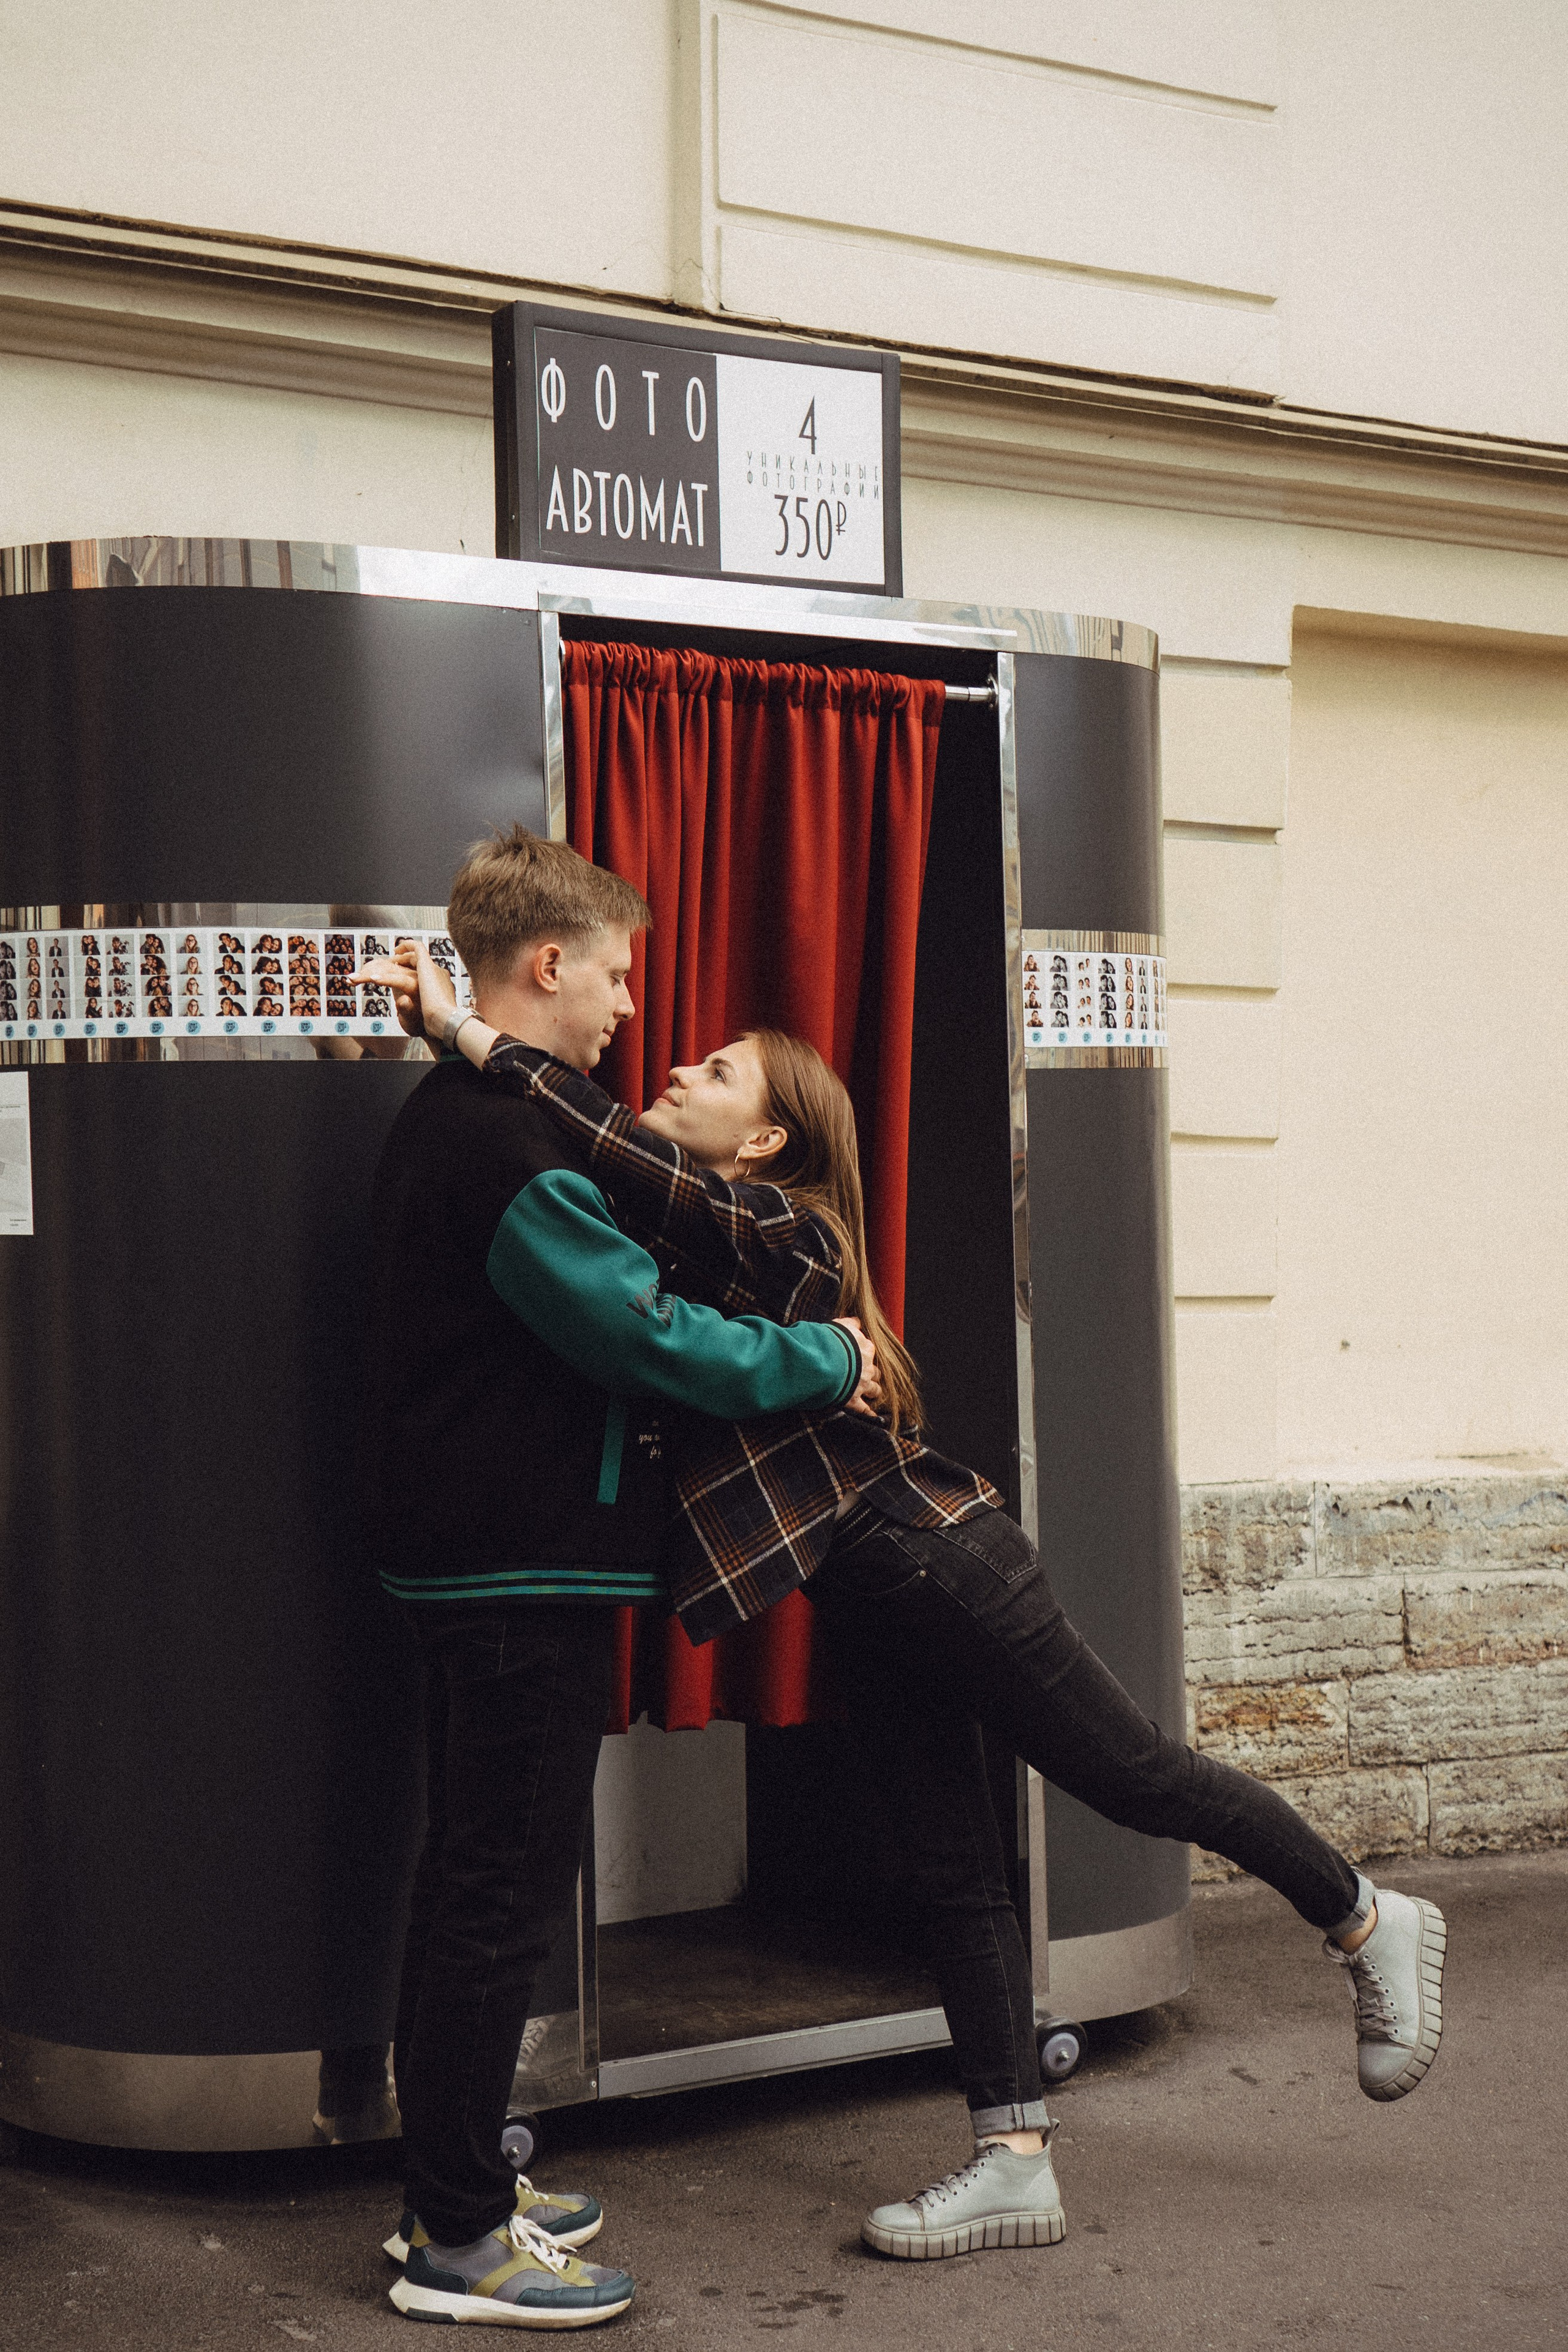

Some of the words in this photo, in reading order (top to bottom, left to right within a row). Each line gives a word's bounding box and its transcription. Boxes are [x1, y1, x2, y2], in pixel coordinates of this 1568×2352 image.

[541, 358, 707, 442] ФОТО
[799, 395, 816, 454] 4
[747, 451, 878, 481] УНИКАЛЬНЫЕ
[747, 470, 879, 500] ФОТОГРАФИИ
[546, 464, 708, 547] АВТОМАТ
